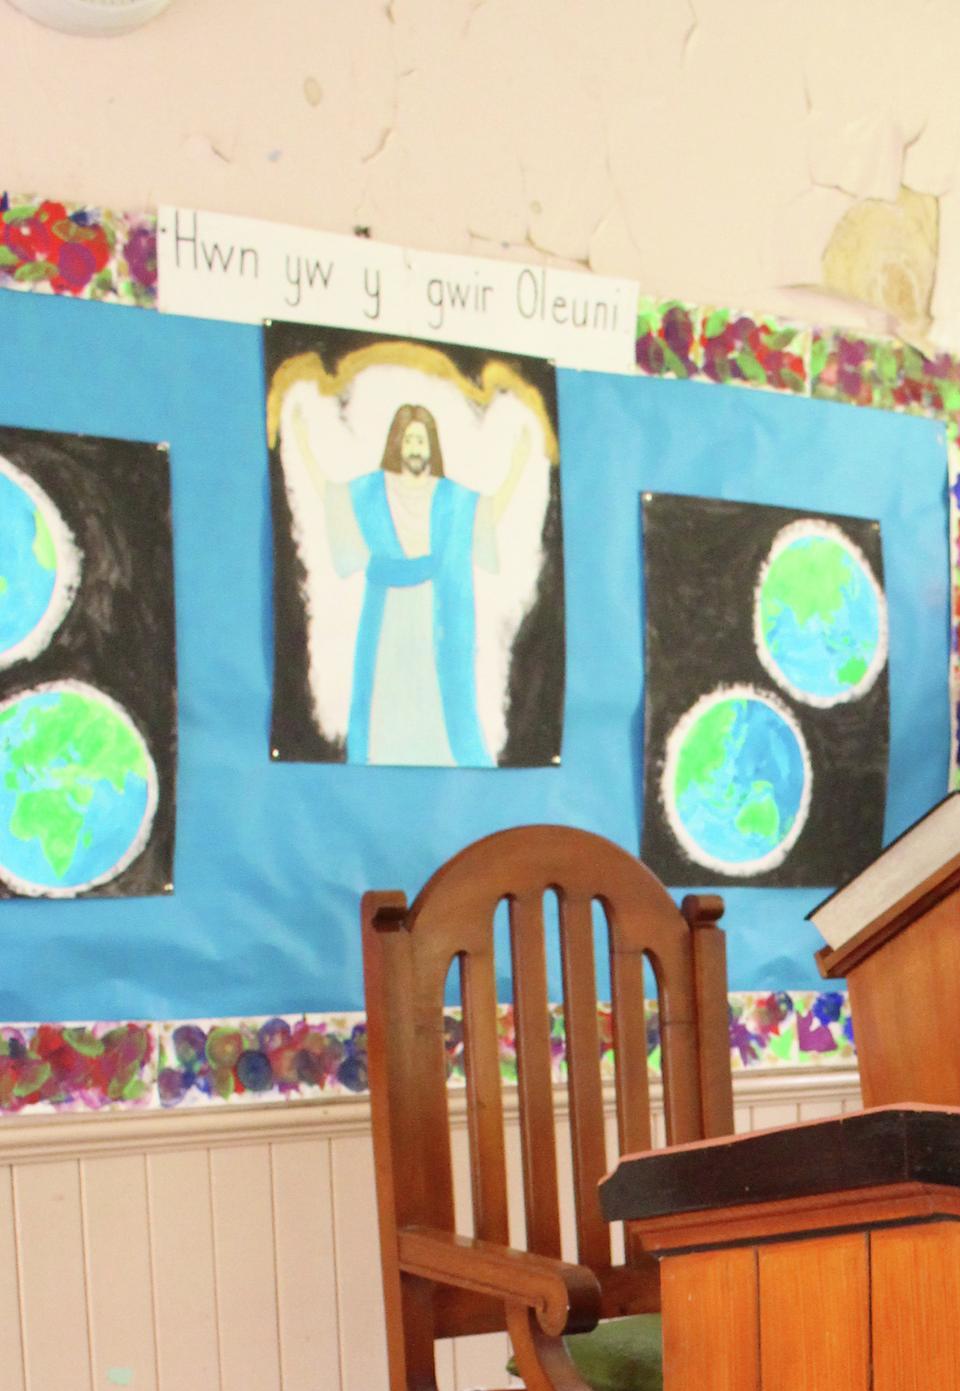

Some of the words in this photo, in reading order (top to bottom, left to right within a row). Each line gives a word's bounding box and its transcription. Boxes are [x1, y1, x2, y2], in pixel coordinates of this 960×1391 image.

[174, 209, 260, 279] Hwn
[286, 252, 335, 307] yw
[363, 266, 382, 320] y
[427, 271, 494, 331] gwir
[515, 266, 621, 332] Oleuni
